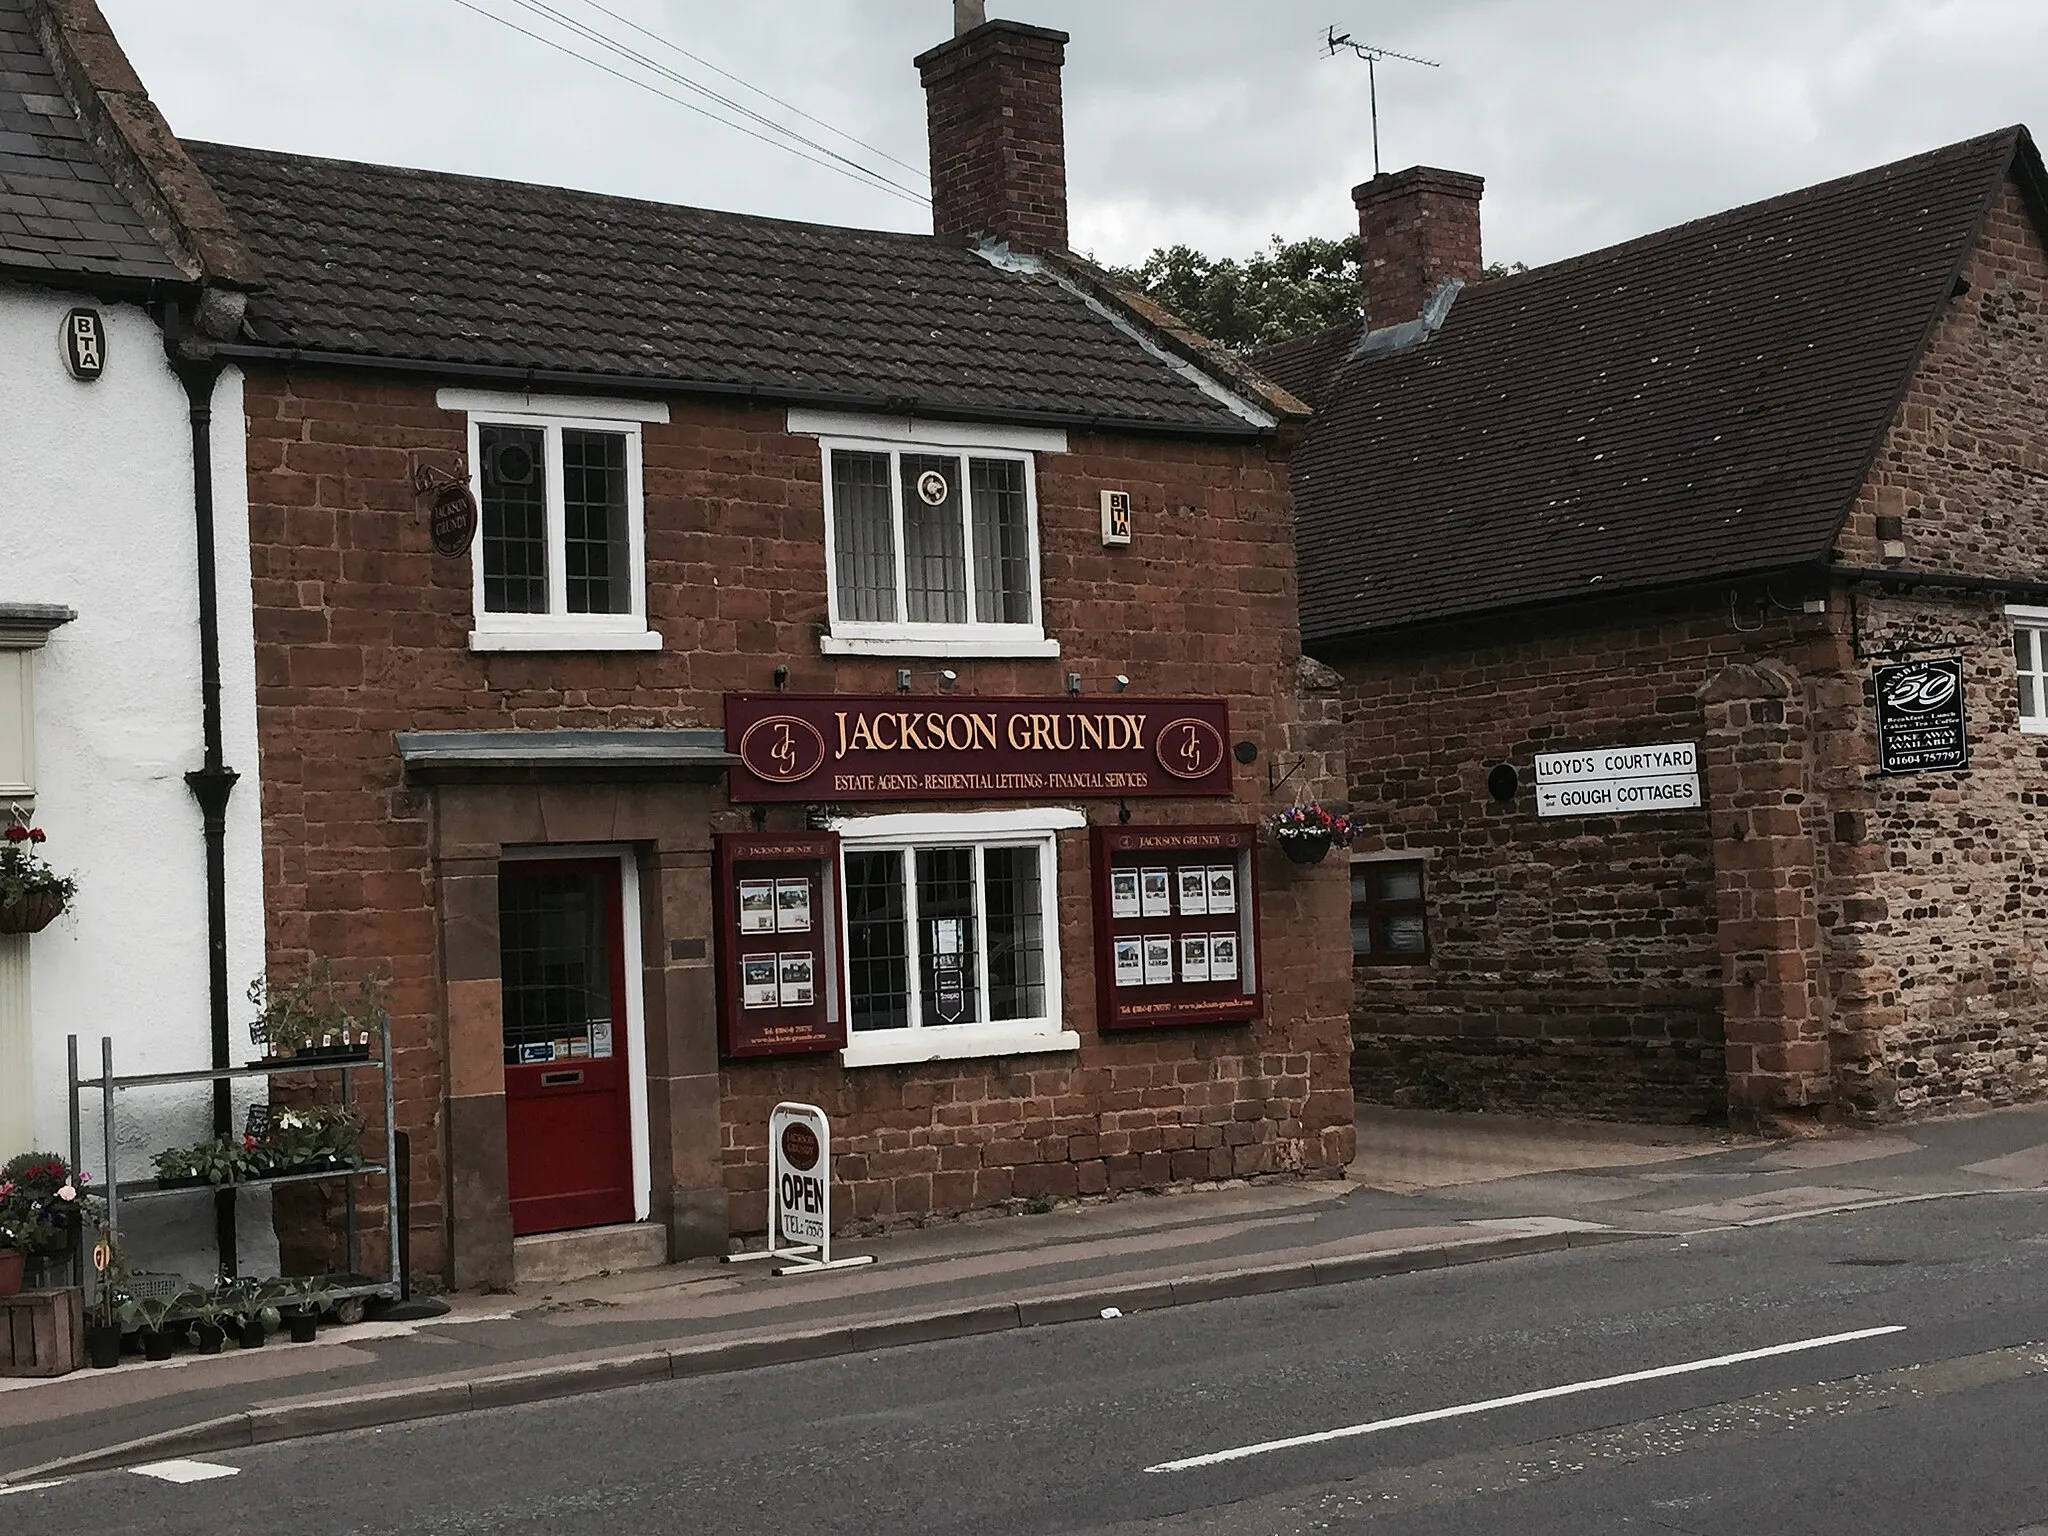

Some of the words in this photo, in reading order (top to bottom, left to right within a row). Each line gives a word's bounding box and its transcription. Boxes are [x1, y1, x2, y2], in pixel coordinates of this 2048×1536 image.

[77, 318, 98, 367] BTA
[1111, 495, 1128, 535] BTA
[1882, 662, 1929, 693] NUMBER
[1887, 672, 1956, 706] 50
[1931, 711, 1956, 719] Lunch
[834, 712, 997, 760] JACKSON
[1008, 713, 1147, 750] GRUNDY
[1886, 733, 1921, 743] TAKE
[1923, 729, 1957, 739] AWAY
[1888, 737, 1958, 750] AVAILABLE
[1538, 757, 1595, 776] LLOYD'S
[1605, 750, 1693, 771] COURTYARD
[1889, 754, 1921, 765] 01604
[1923, 750, 1960, 762] 757797
[834, 775, 875, 791] ESTATE
[877, 774, 918, 790] AGENTS
[924, 773, 994, 790] RESIDENTIAL
[995, 773, 1043, 789] LETTINGS
[1050, 772, 1104, 788] FINANCIAL
[1105, 772, 1148, 788] SERVICES
[1560, 789, 1612, 806] GOUGH
[1617, 783, 1693, 802] COTTAGES
[749, 846, 781, 856] JACKSON
[1139, 835, 1180, 848] JACKSON
[1183, 835, 1221, 845] GRUNDY
[781, 1172, 824, 1215] OPEN
[784, 1214, 804, 1235] TEL:
